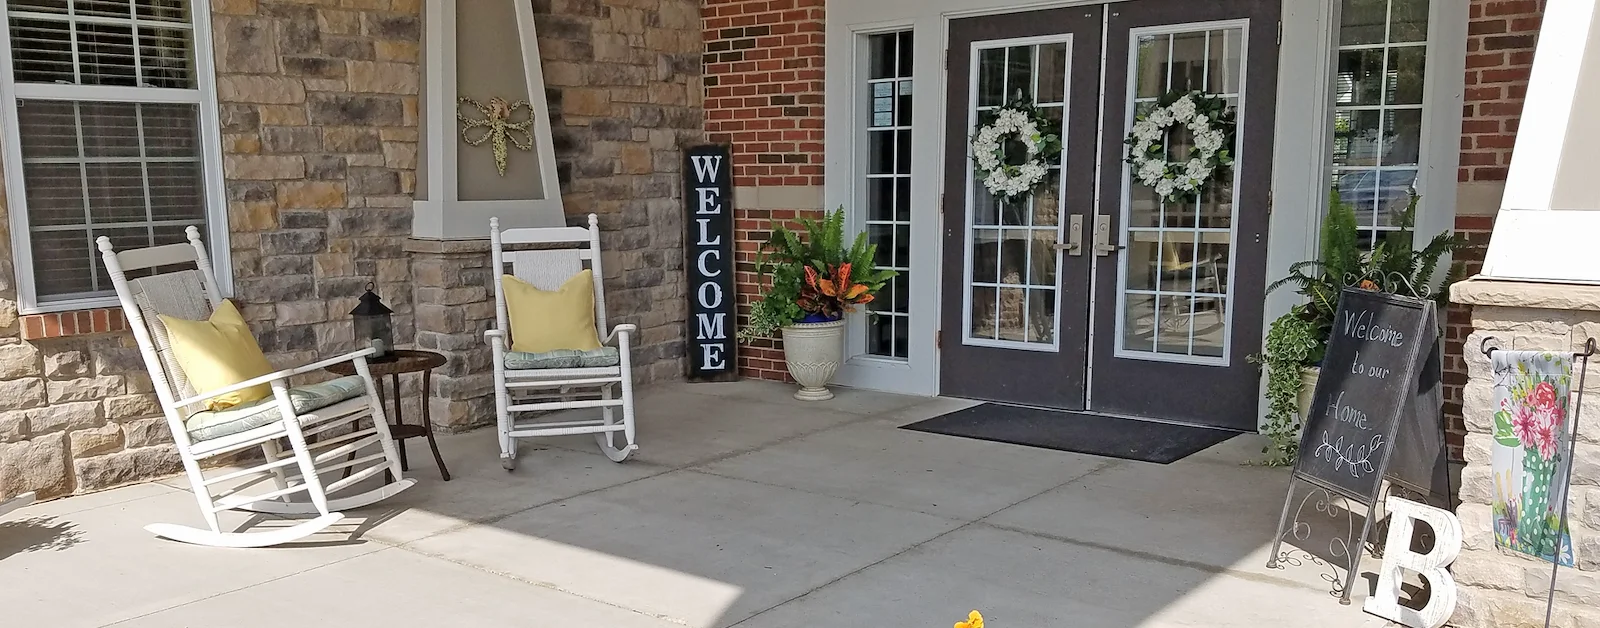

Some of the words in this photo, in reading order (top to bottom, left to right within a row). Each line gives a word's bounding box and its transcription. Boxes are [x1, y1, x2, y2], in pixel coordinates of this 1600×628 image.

[691, 156, 726, 369] WELCOME
[1344, 309, 1404, 347] Welcome
[1352, 351, 1364, 374] to
[1368, 365, 1390, 379] our
[1363, 496, 1463, 628] B
